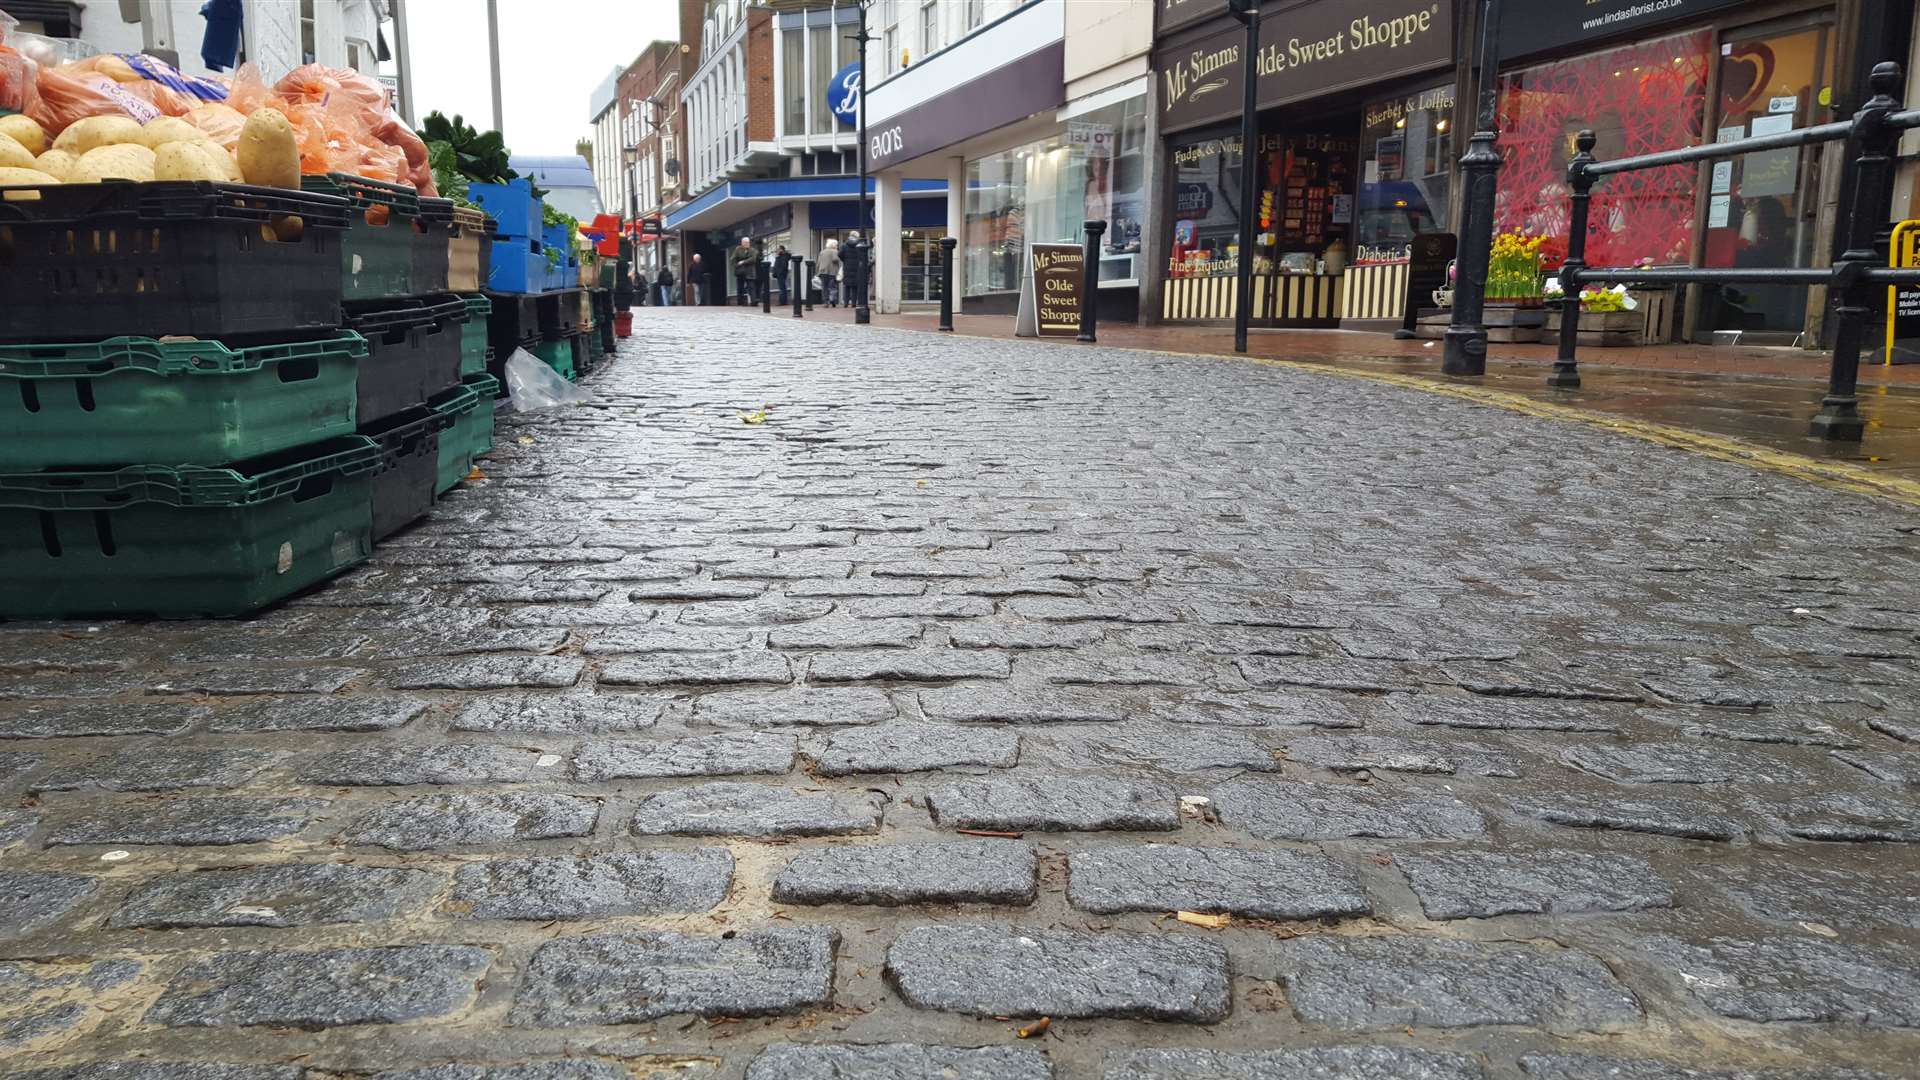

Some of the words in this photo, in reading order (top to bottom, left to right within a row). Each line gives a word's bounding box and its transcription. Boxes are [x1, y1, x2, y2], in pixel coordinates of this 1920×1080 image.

[1582, 0, 1682, 29] www.lindasflorist.co.uk
[1164, 61, 1188, 112] Mr
[1191, 44, 1239, 83] Simms
[1288, 31, 1345, 68] Sweet
[1405, 98, 1415, 112] &
[1419, 91, 1455, 110] Lollies
[871, 126, 903, 160] evans
[1174, 147, 1202, 164] Fudge
[1205, 144, 1215, 155] &
[1033, 252, 1050, 271] Mr
[1051, 250, 1083, 264] Simms
[1357, 244, 1400, 262] Diabetic
[1168, 257, 1193, 272] Fine
[1045, 278, 1073, 291] Olde
[1043, 293, 1077, 306] Sweet
